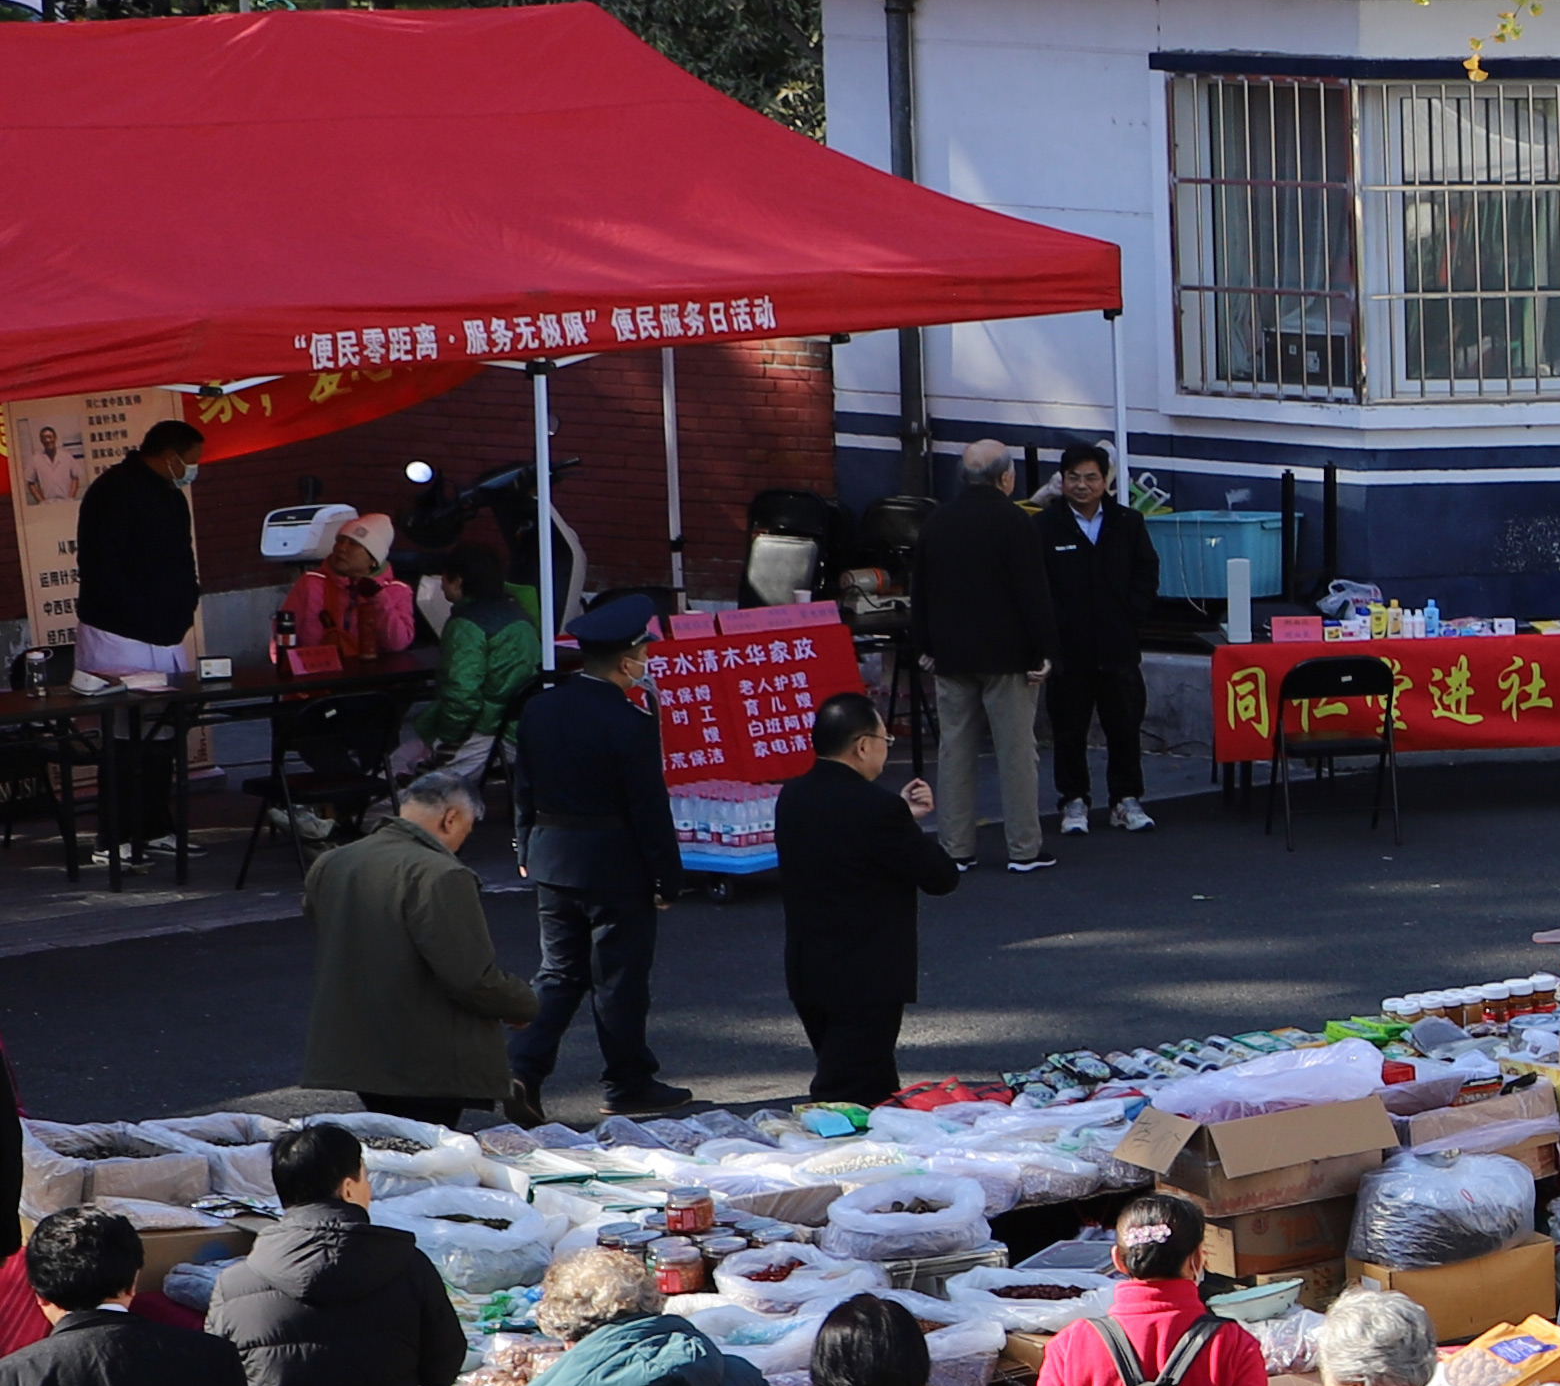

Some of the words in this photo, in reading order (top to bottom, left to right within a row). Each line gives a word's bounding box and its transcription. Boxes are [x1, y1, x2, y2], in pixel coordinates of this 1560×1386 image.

[611, 295, 776, 341] 便民服务日活动
[738, 671, 809, 696] 老人护理
